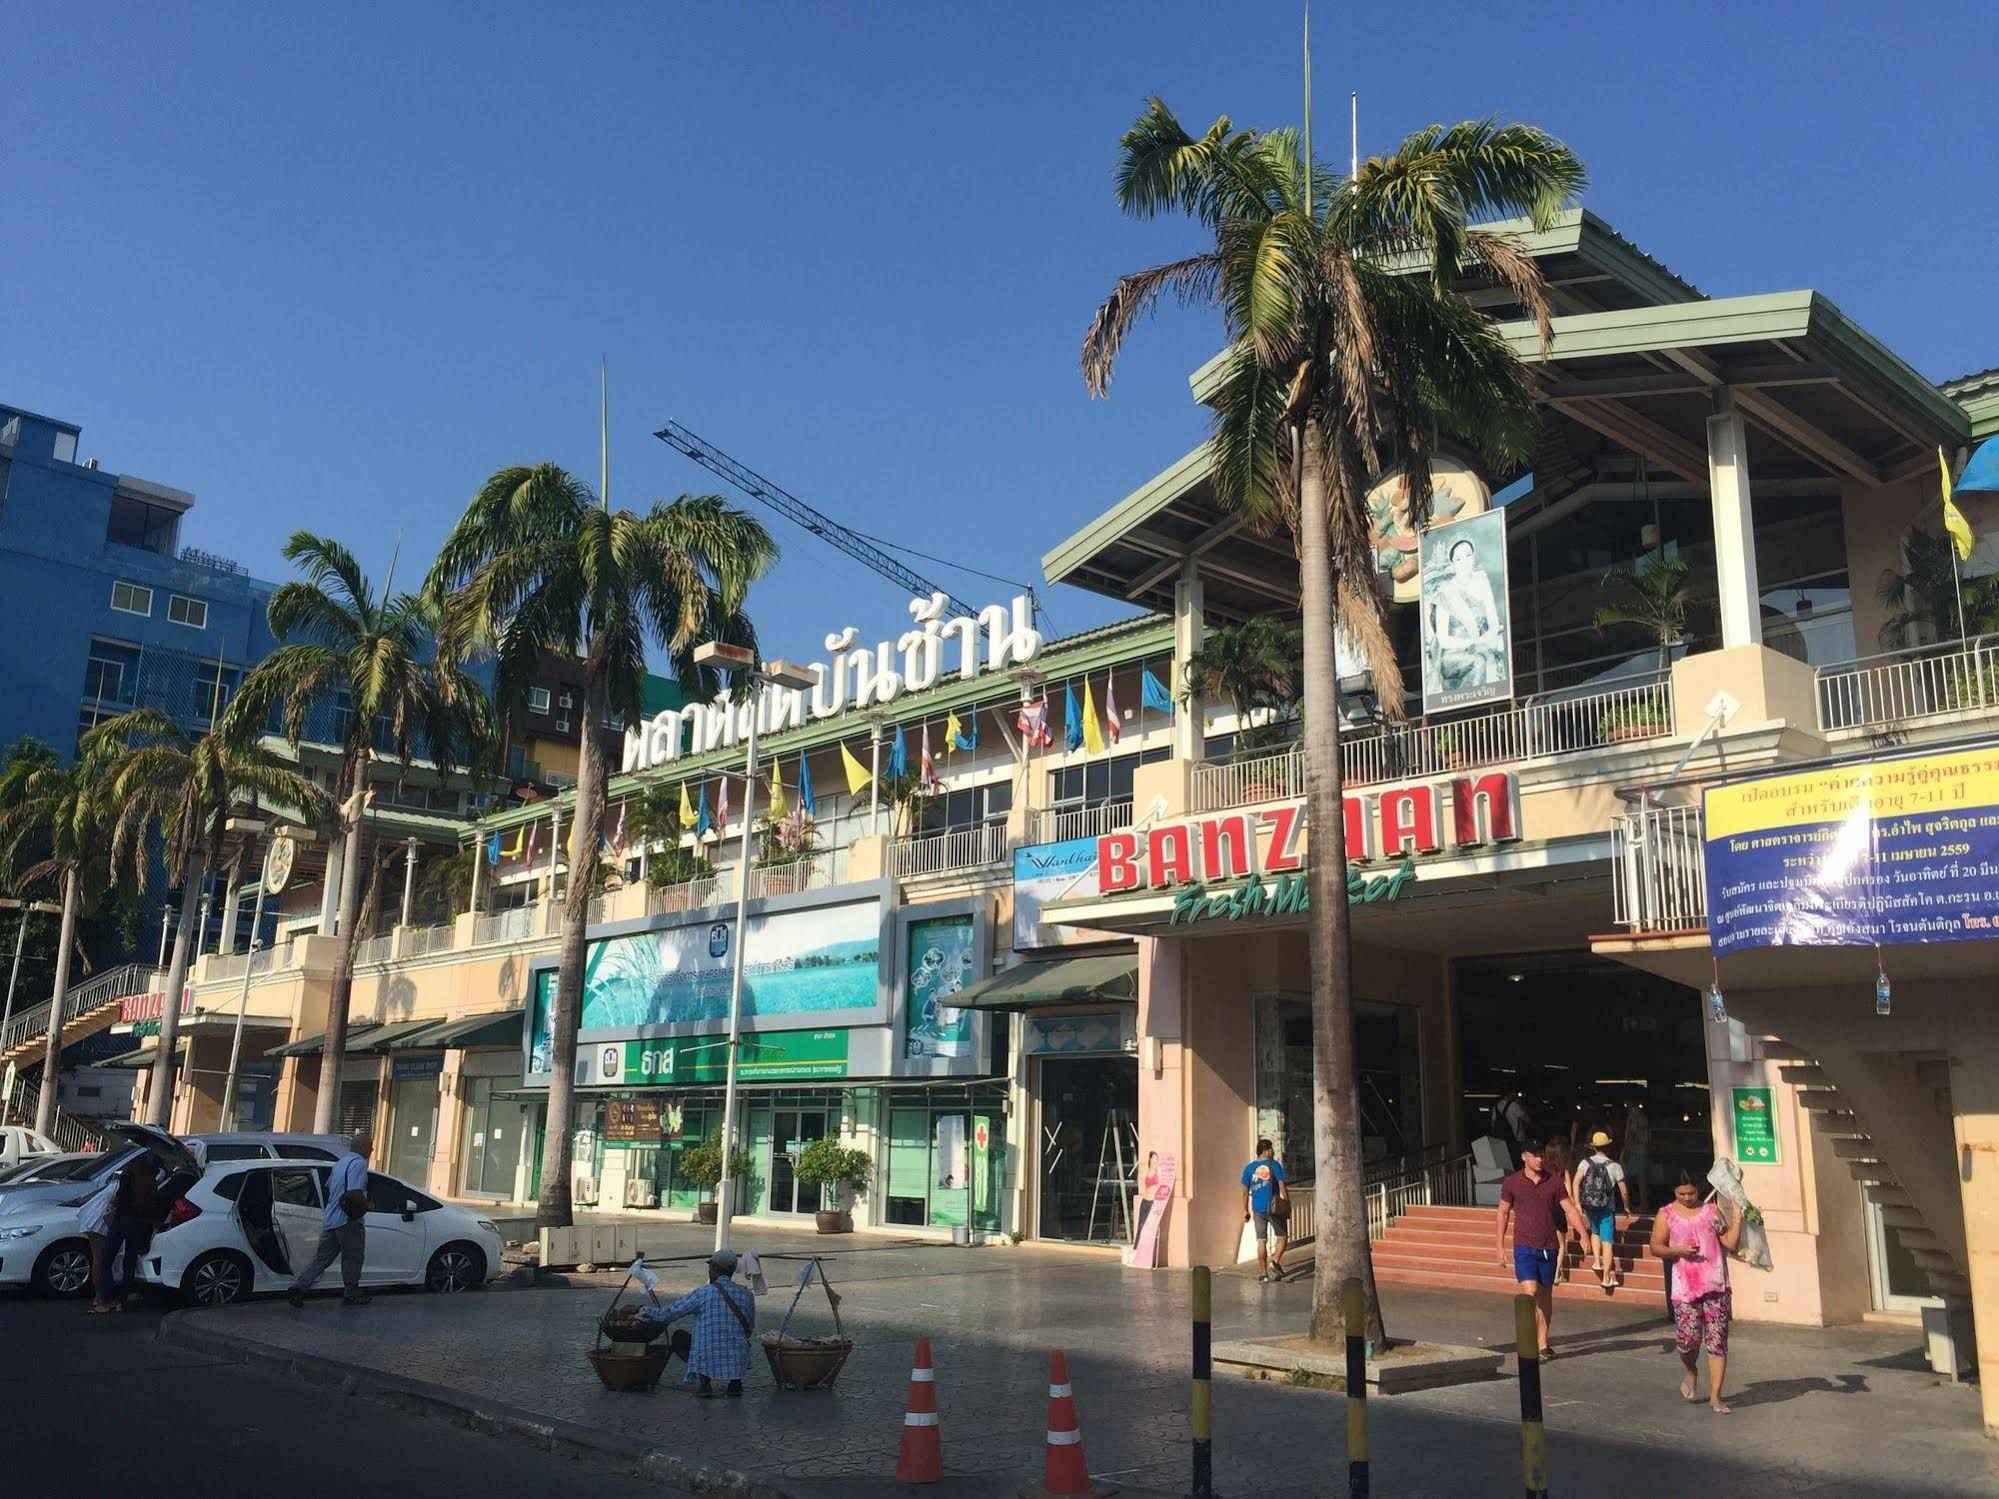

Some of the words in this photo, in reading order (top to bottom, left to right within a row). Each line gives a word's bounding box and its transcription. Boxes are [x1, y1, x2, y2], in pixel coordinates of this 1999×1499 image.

[1910, 789, 1943, 804] 7-11
[1953, 782, 1965, 800] ปี
[1729, 839, 1749, 853] โดย
[1783, 853, 1827, 868] ระหว่า
[1941, 843, 1970, 857] 2559
[1962, 867, 1976, 878] 20
[1170, 873, 1266, 926] Fresh
[1264, 858, 1418, 917] Mket
[641, 1047, 674, 1075] ธกส
